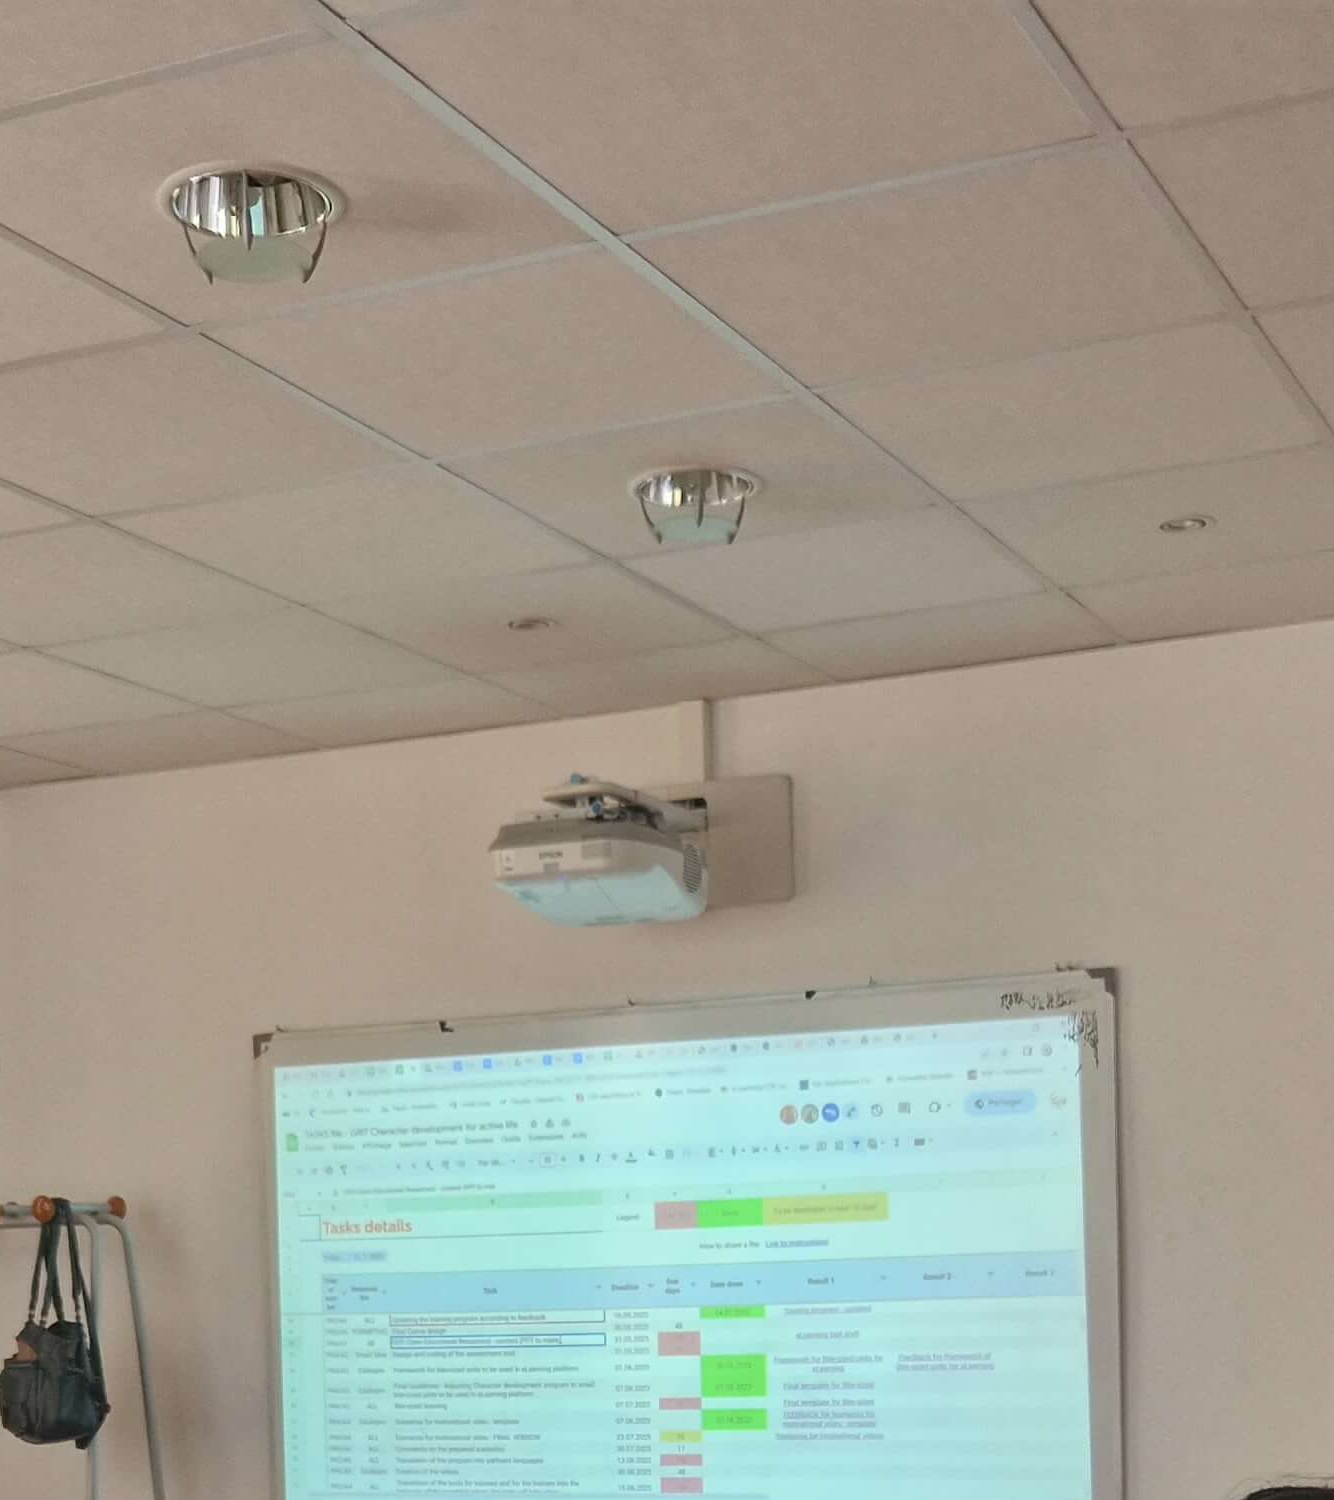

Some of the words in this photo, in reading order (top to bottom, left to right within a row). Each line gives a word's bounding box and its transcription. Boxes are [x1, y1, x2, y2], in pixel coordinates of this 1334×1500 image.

[371, 1125, 408, 1136] Character
[411, 1123, 462, 1135] development
[466, 1122, 476, 1131] for
[479, 1120, 503, 1130] active
[506, 1120, 517, 1129] life
[323, 1220, 360, 1234] Tasks
[364, 1219, 411, 1233] details
